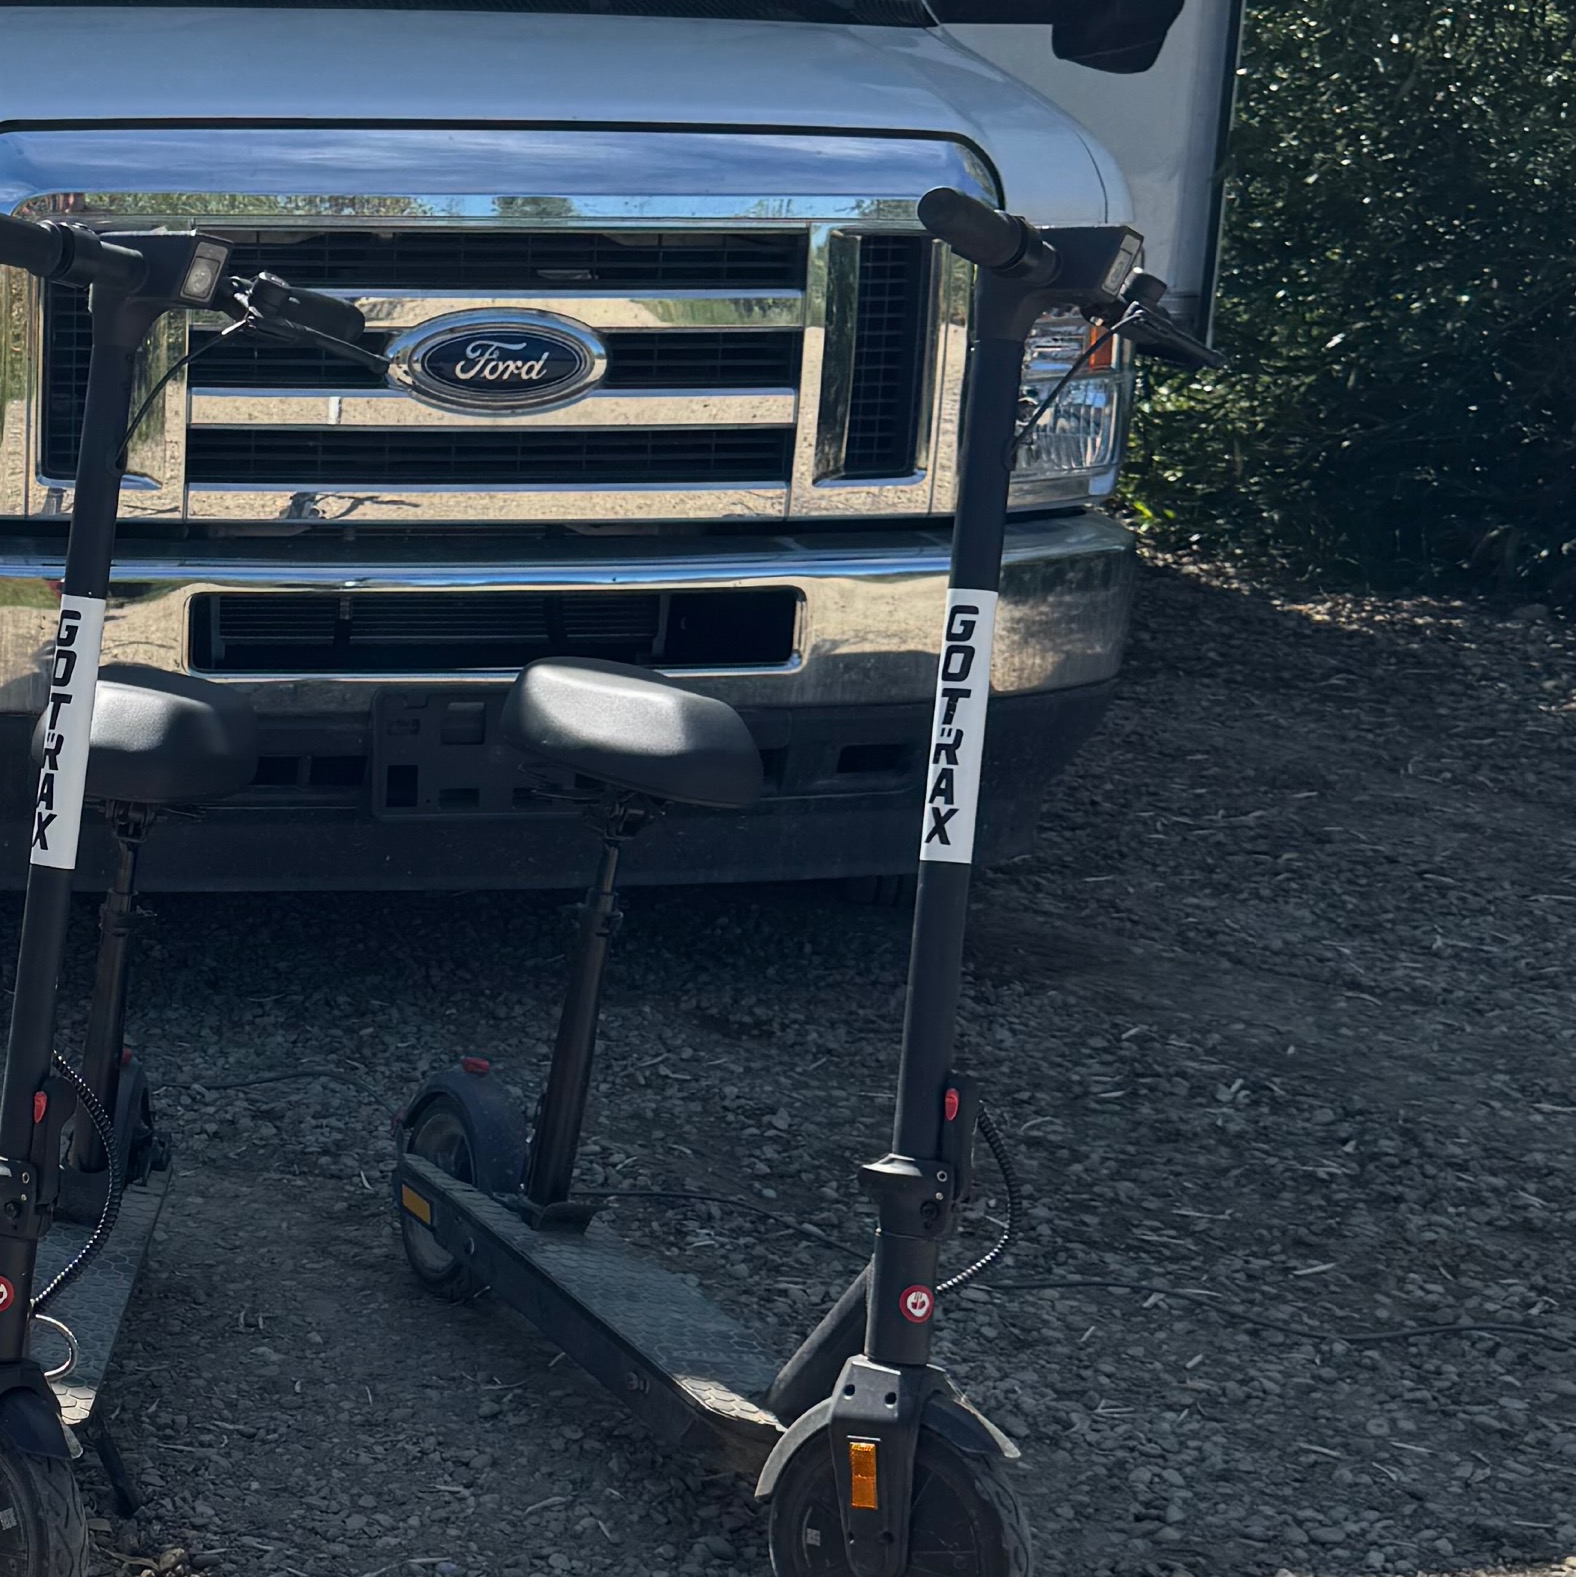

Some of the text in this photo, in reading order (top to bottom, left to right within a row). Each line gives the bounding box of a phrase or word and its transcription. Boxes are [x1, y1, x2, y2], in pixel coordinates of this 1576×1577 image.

[454, 339, 549, 381] Ford
[31, 609, 82, 851] GOTRAX
[924, 604, 980, 846] GOTRAX
